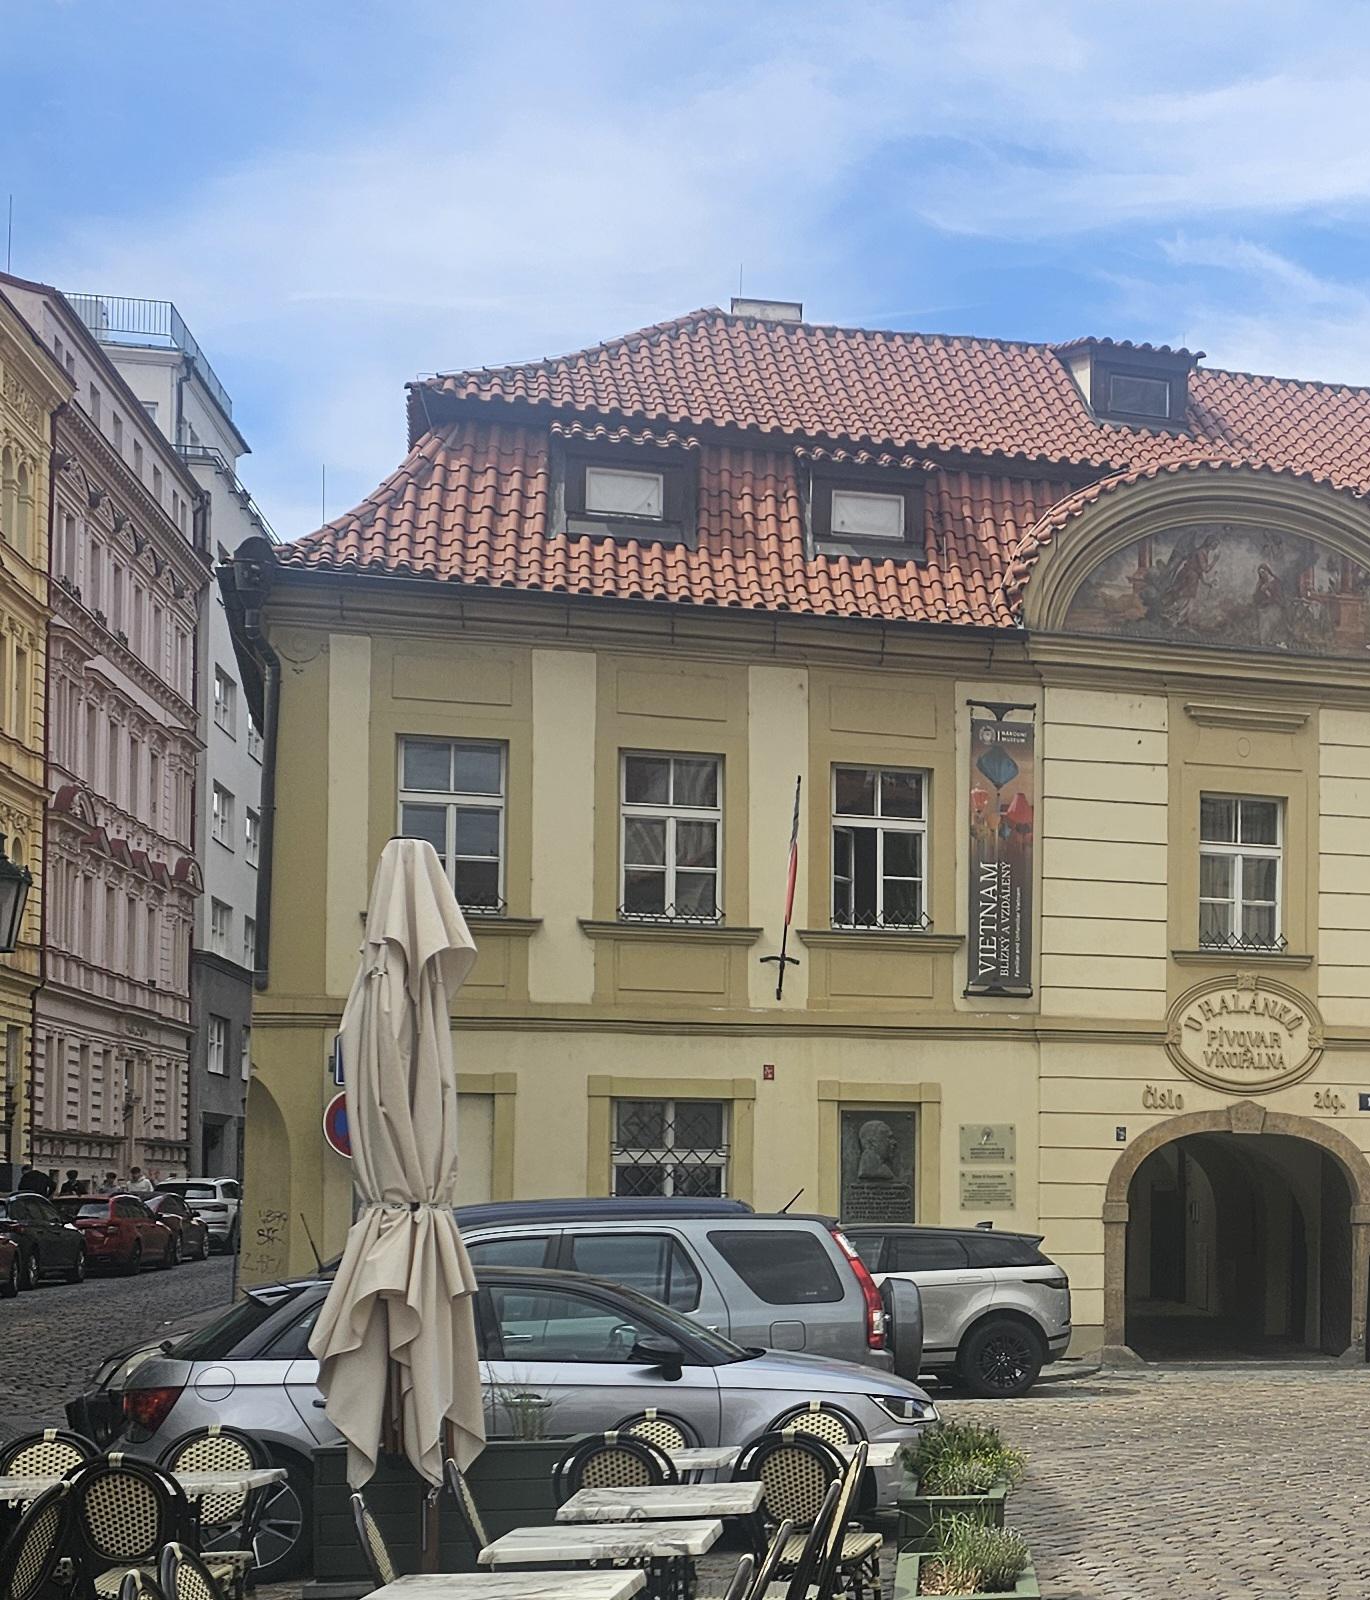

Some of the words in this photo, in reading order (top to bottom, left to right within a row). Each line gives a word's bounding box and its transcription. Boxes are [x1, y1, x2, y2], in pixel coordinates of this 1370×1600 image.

[999, 861, 1011, 923] VZDÁLENÝ
[978, 862, 998, 976] VIETNAM
[1001, 925, 1010, 935] A
[998, 936, 1010, 976] BLÍZKÝ
[1183, 1014, 1204, 1032] U
[1142, 1085, 1185, 1110] Číslo
